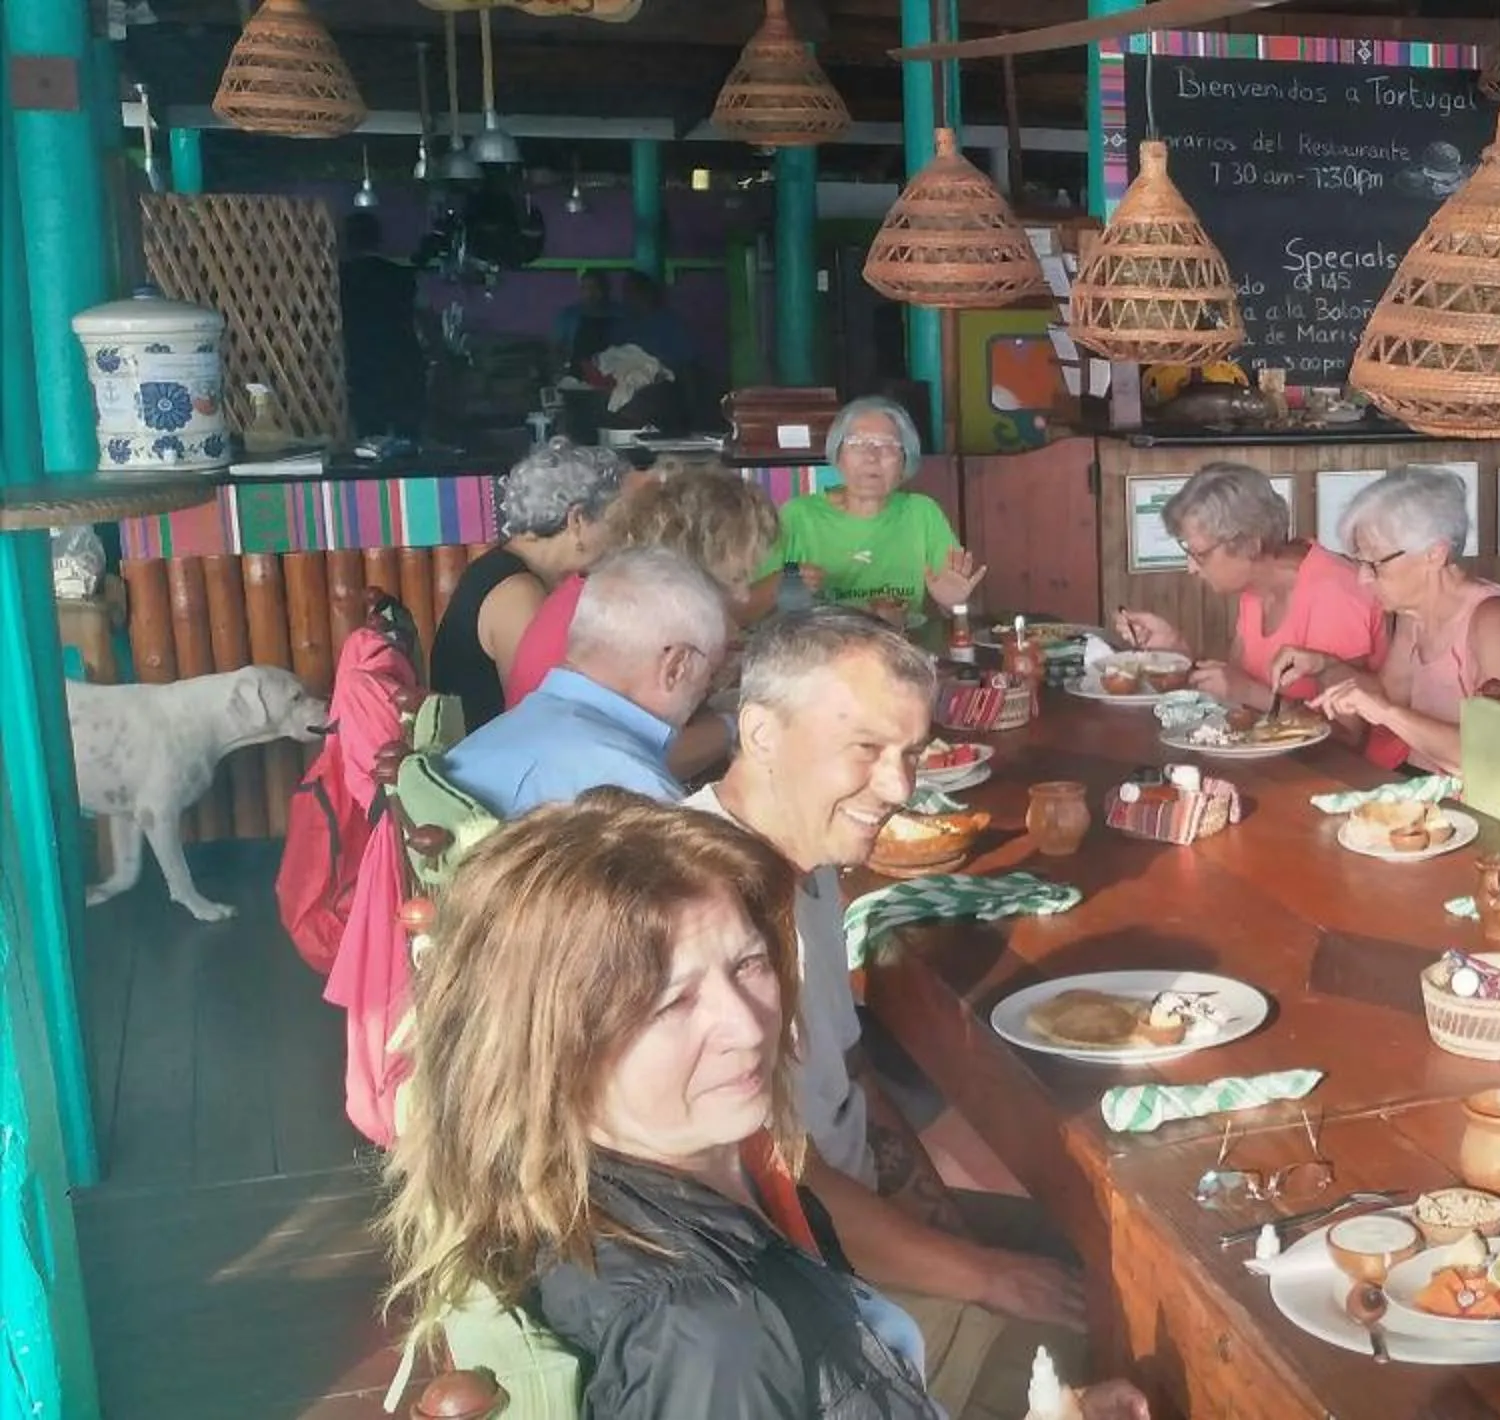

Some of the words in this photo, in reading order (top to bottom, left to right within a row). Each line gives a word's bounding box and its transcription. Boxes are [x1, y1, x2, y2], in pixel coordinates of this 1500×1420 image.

[1176, 66, 1328, 104] Bienvenidos
[1346, 86, 1360, 103] a
[1365, 75, 1477, 117] Tortugal
[1163, 134, 1237, 151] orarios
[1253, 129, 1282, 153] del
[1299, 131, 1411, 162] Restaurante
[1282, 236, 1398, 288] Specials
[1264, 325, 1286, 346] de
